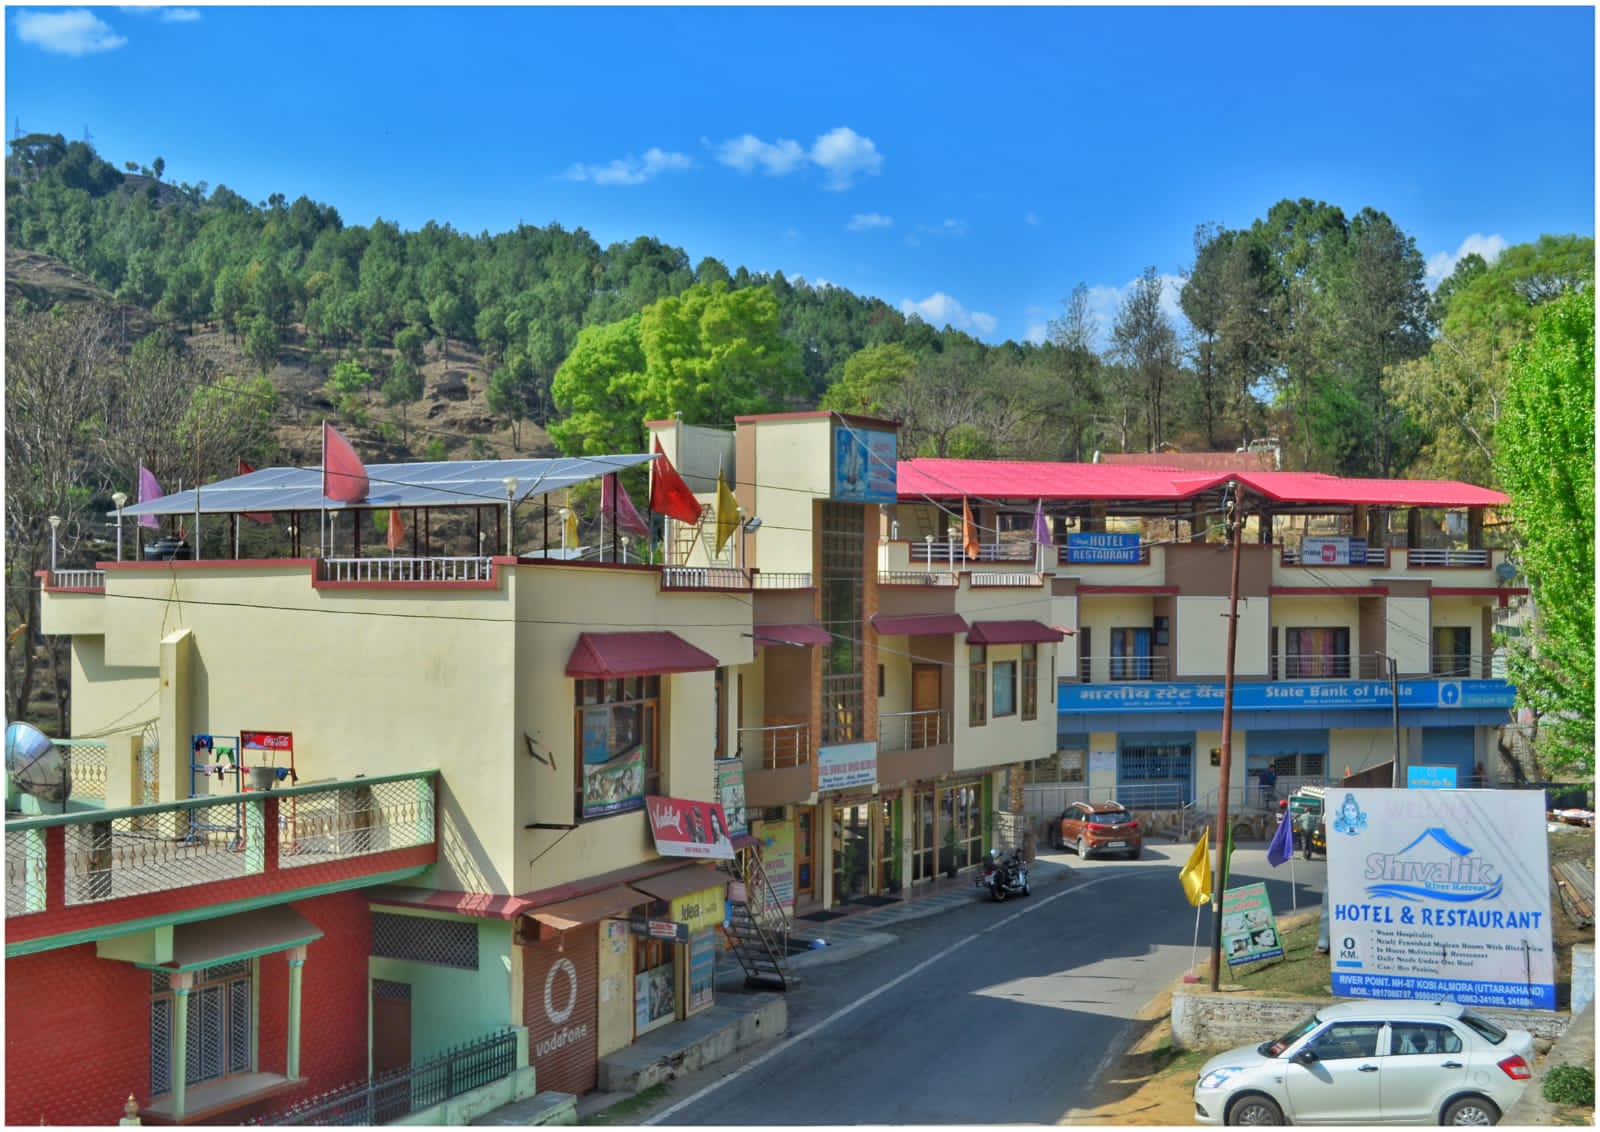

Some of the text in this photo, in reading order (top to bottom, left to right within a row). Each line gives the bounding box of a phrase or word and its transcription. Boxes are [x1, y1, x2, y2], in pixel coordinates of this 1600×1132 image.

[1090, 535, 1124, 547] HOTEL
[1074, 550, 1135, 561] RESTAURANT
[1079, 686, 1150, 700] भारतीय
[1155, 685, 1191, 699] स्टेट
[1265, 685, 1305, 698] State
[1310, 684, 1349, 697] Bank
[1353, 684, 1369, 697] of
[1365, 852, 1495, 885] Shivalik
[1424, 881, 1487, 891] River Retreat
[1335, 904, 1542, 929] HOTEL & RESTAURANT
[1339, 975, 1364, 985] RIVER
[1416, 979, 1437, 989] KOSI
[1438, 981, 1473, 992] ALMORA
[1474, 983, 1545, 998] (UTTARAKHAND)
[536, 1023, 588, 1057] vodafone
